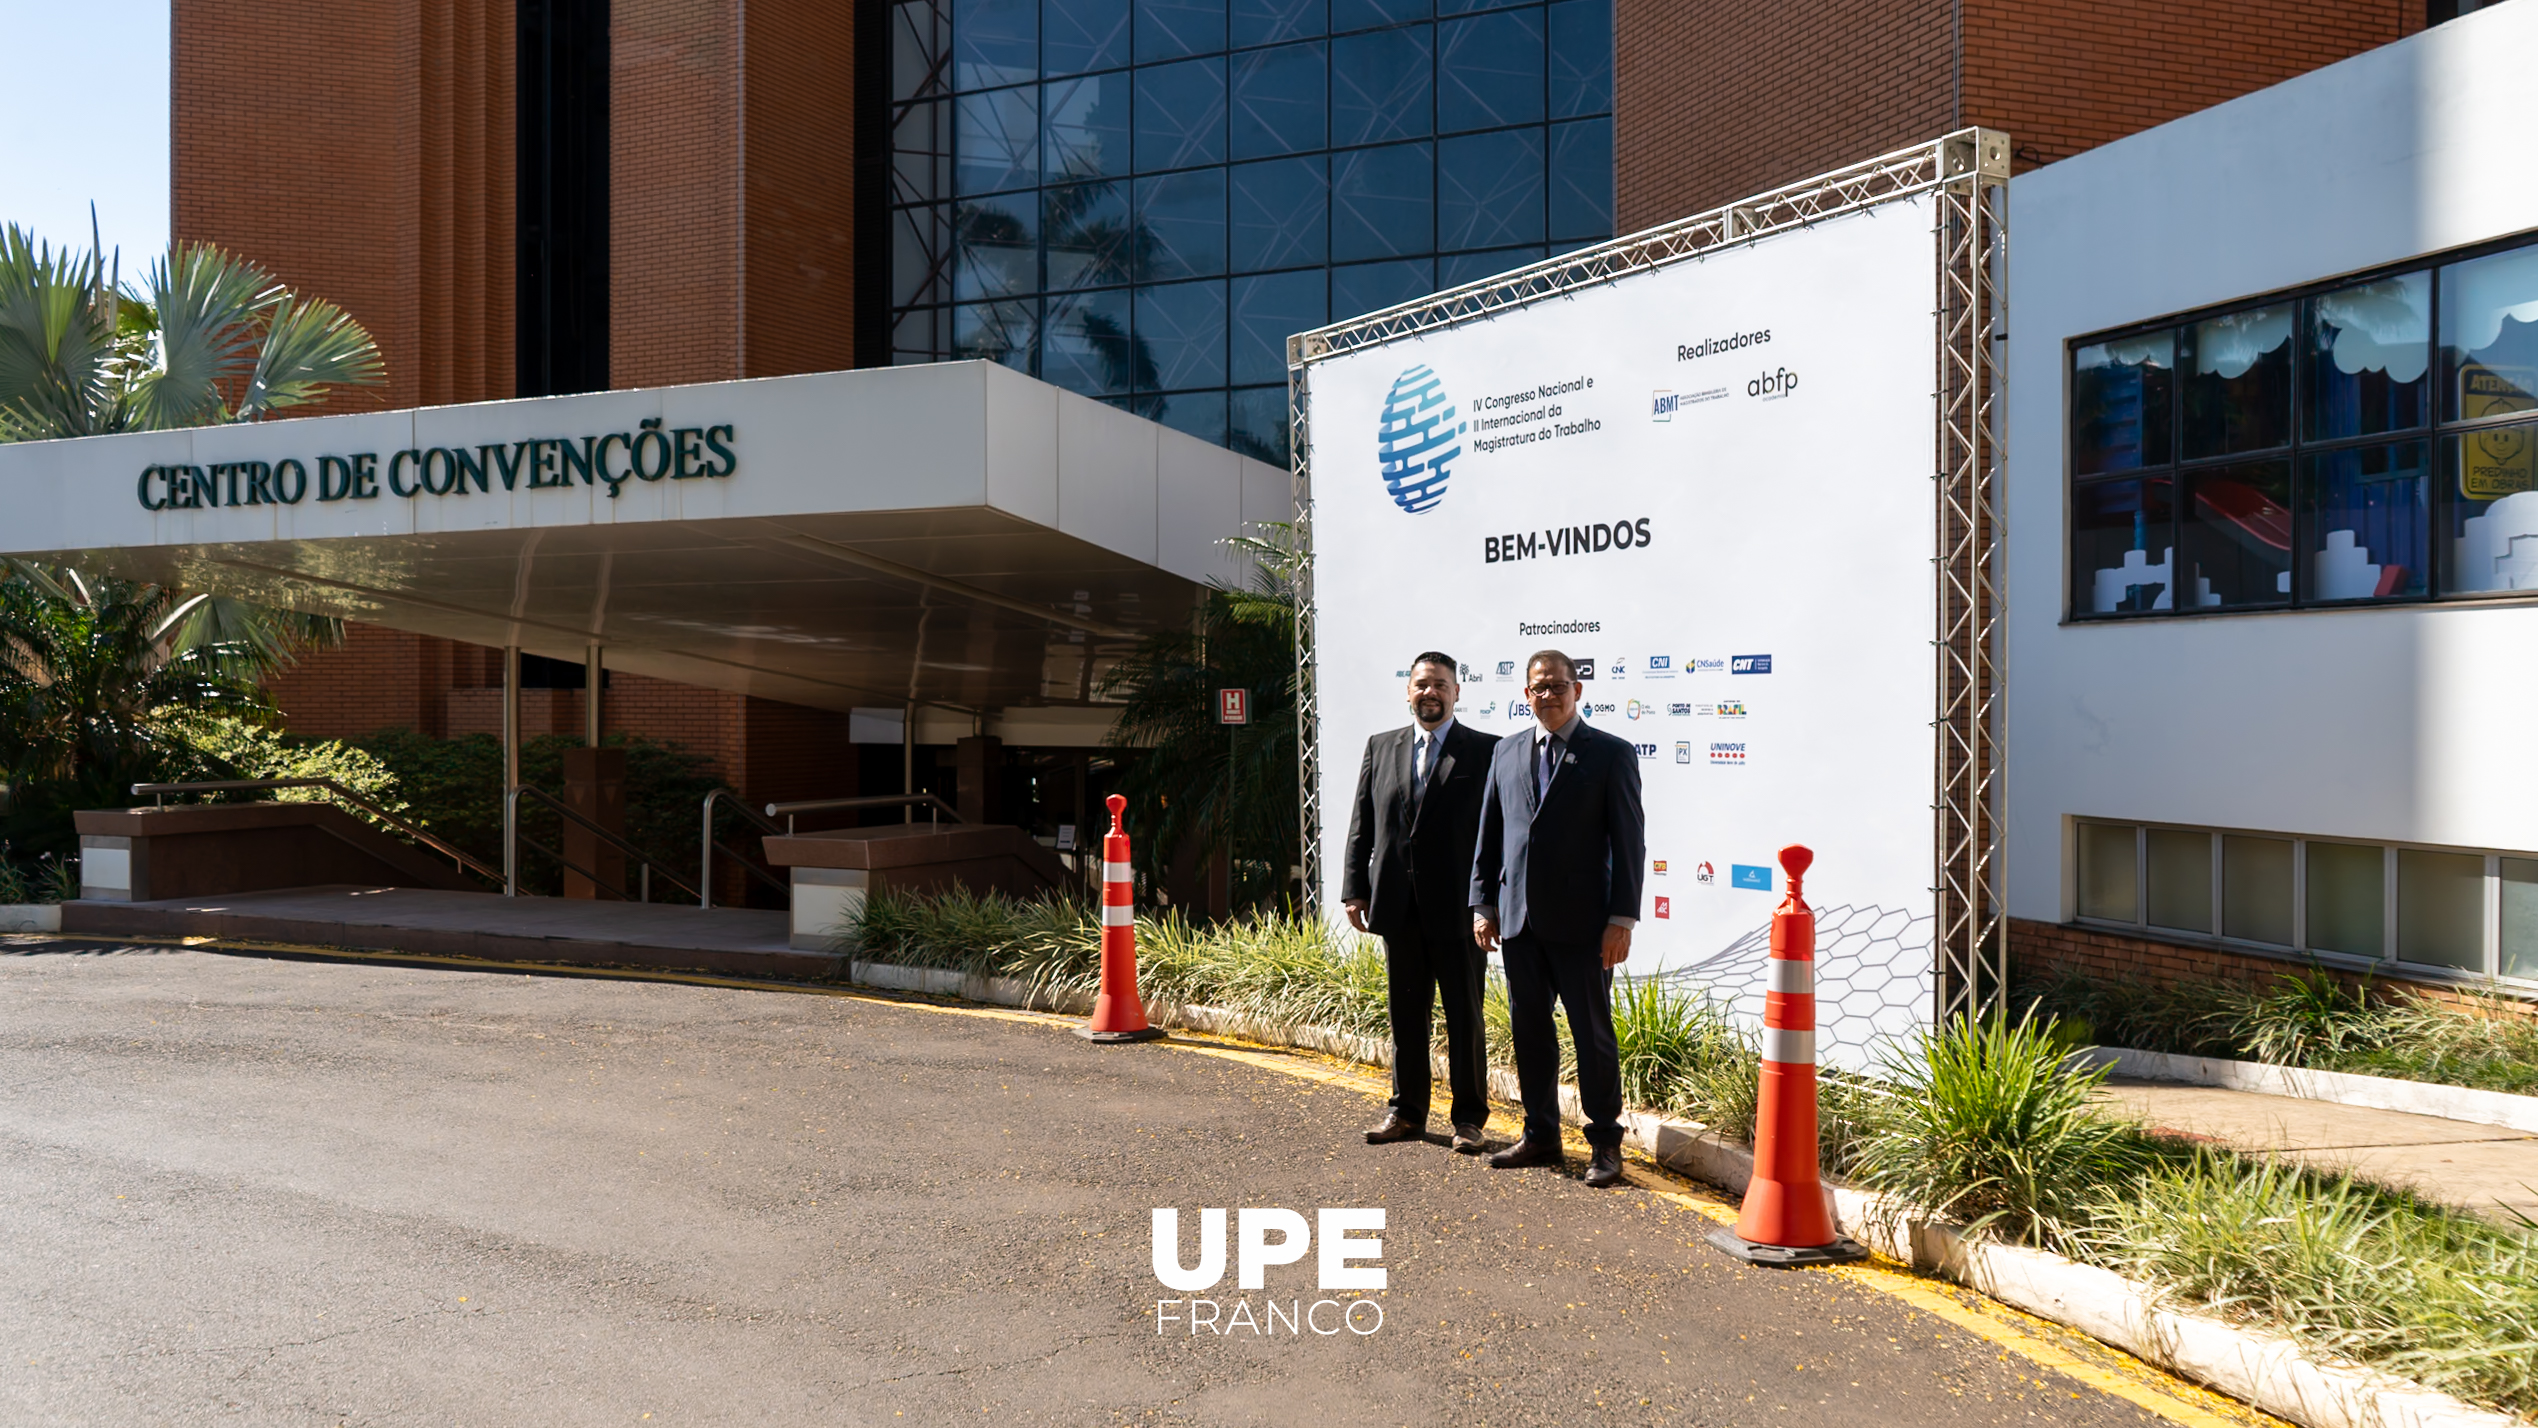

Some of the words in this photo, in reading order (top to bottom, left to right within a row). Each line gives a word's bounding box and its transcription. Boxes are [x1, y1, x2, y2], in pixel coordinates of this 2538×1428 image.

[1677, 328, 1771, 362] Realizadores
[1747, 366, 1798, 397] abfp
[1473, 398, 1483, 412] IV
[1484, 390, 1536, 409] Congresso
[1538, 375, 1584, 399] Nacional
[1586, 377, 1594, 388] e
[1653, 394, 1679, 415] ABMT
[1473, 419, 1479, 432] II
[1481, 405, 1546, 431] Internacional
[1548, 404, 1562, 418] da
[1473, 432, 1536, 453] Magistratura
[1538, 427, 1552, 441] do
[1554, 418, 1601, 438] Trabalho
[137, 458, 307, 512] CENTRO
[315, 452, 380, 502] DE
[388, 417, 737, 499] CONVENÇÕES
[2470, 478, 2488, 489] EM
[2491, 478, 2530, 490] OBRAS
[1485, 517, 1652, 563] BEM-VINDOS
[1519, 619, 1601, 636] Patrocinadores
[1575, 664, 1593, 675] YD
[1651, 657, 1668, 668] CNI
[1696, 659, 1724, 668] CNSaúde
[1733, 658, 1754, 671] CNT
[1226, 692, 1240, 709] H
[1594, 703, 1615, 713] OGMO
[1513, 703, 1531, 716] JBS
[1710, 743, 1746, 752] UNINOVE
[1697, 873, 1714, 883] UGT
